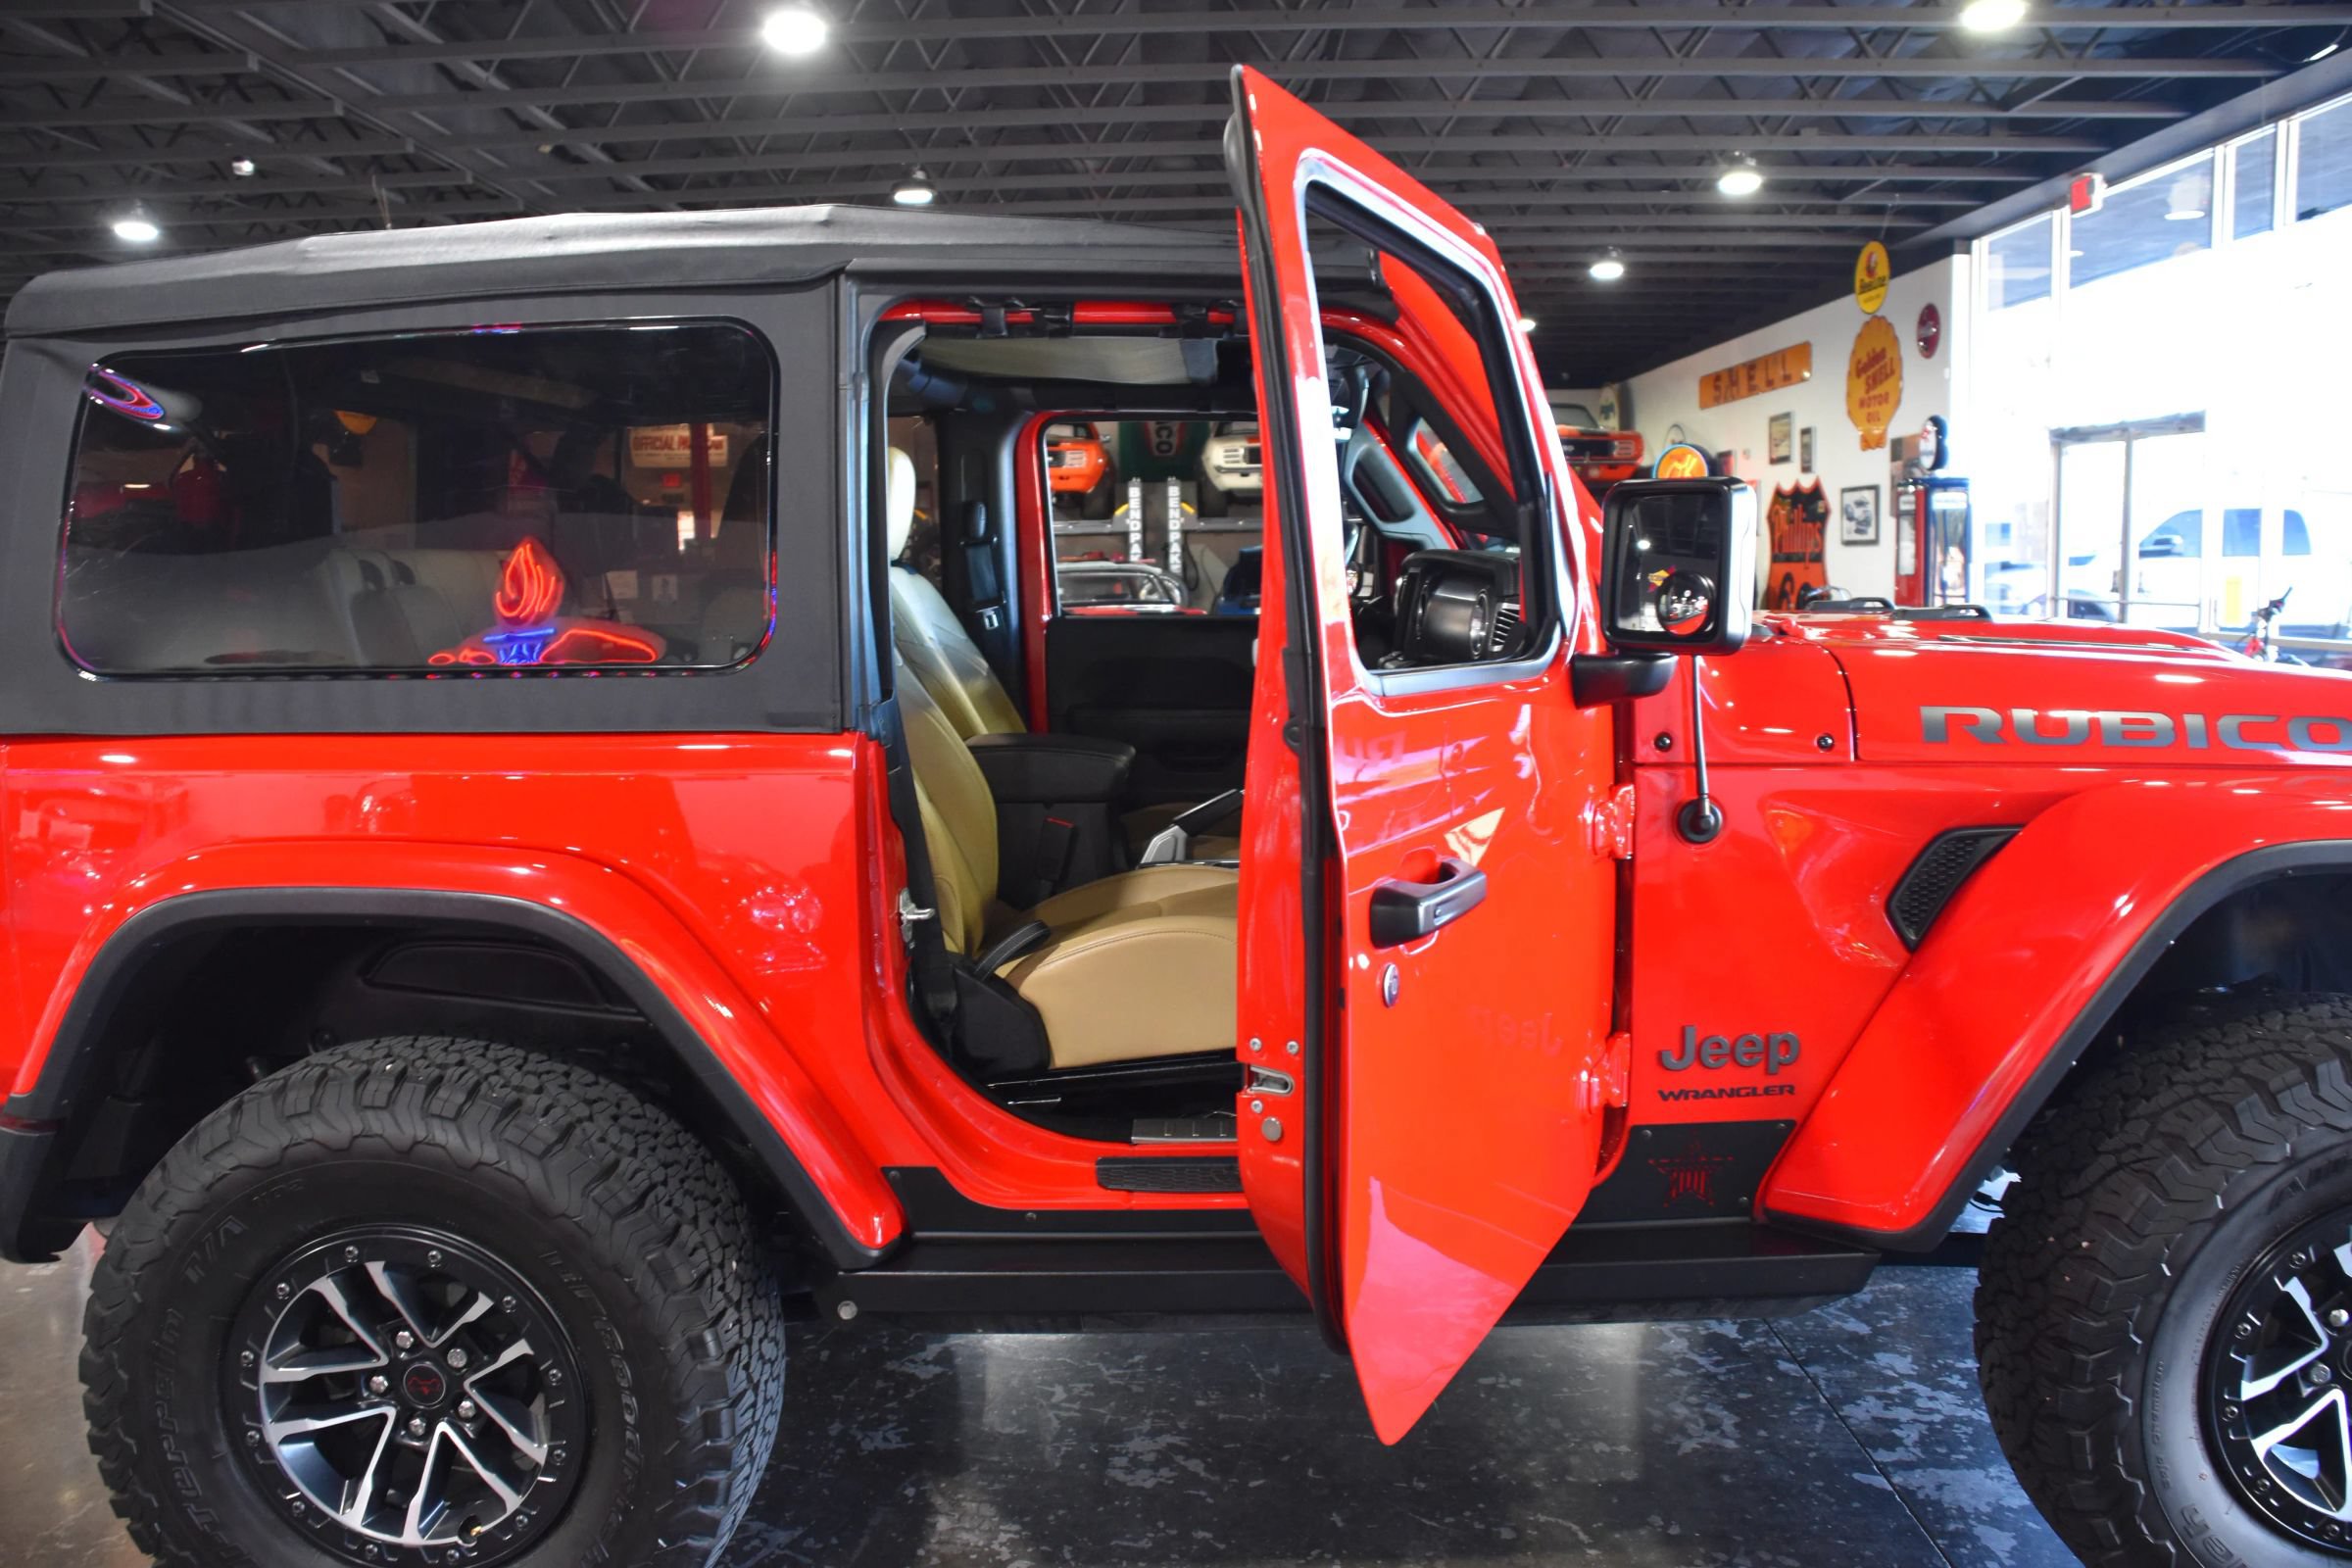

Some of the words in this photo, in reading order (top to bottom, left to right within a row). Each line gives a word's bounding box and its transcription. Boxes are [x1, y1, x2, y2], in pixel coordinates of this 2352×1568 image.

[1712, 352, 1792, 403] SHELL
[1855, 347, 1886, 379] Golden
[1865, 357, 1895, 395] SHELL
[1858, 391, 1889, 410] MOTOR
[1865, 411, 1881, 423] OIL
[633, 435, 675, 451] OFFICIAL
[1772, 503, 1823, 570] Phillips
[1658, 1025, 1800, 1075] Jeep
[1657, 1084, 1796, 1102] WRANGLER
